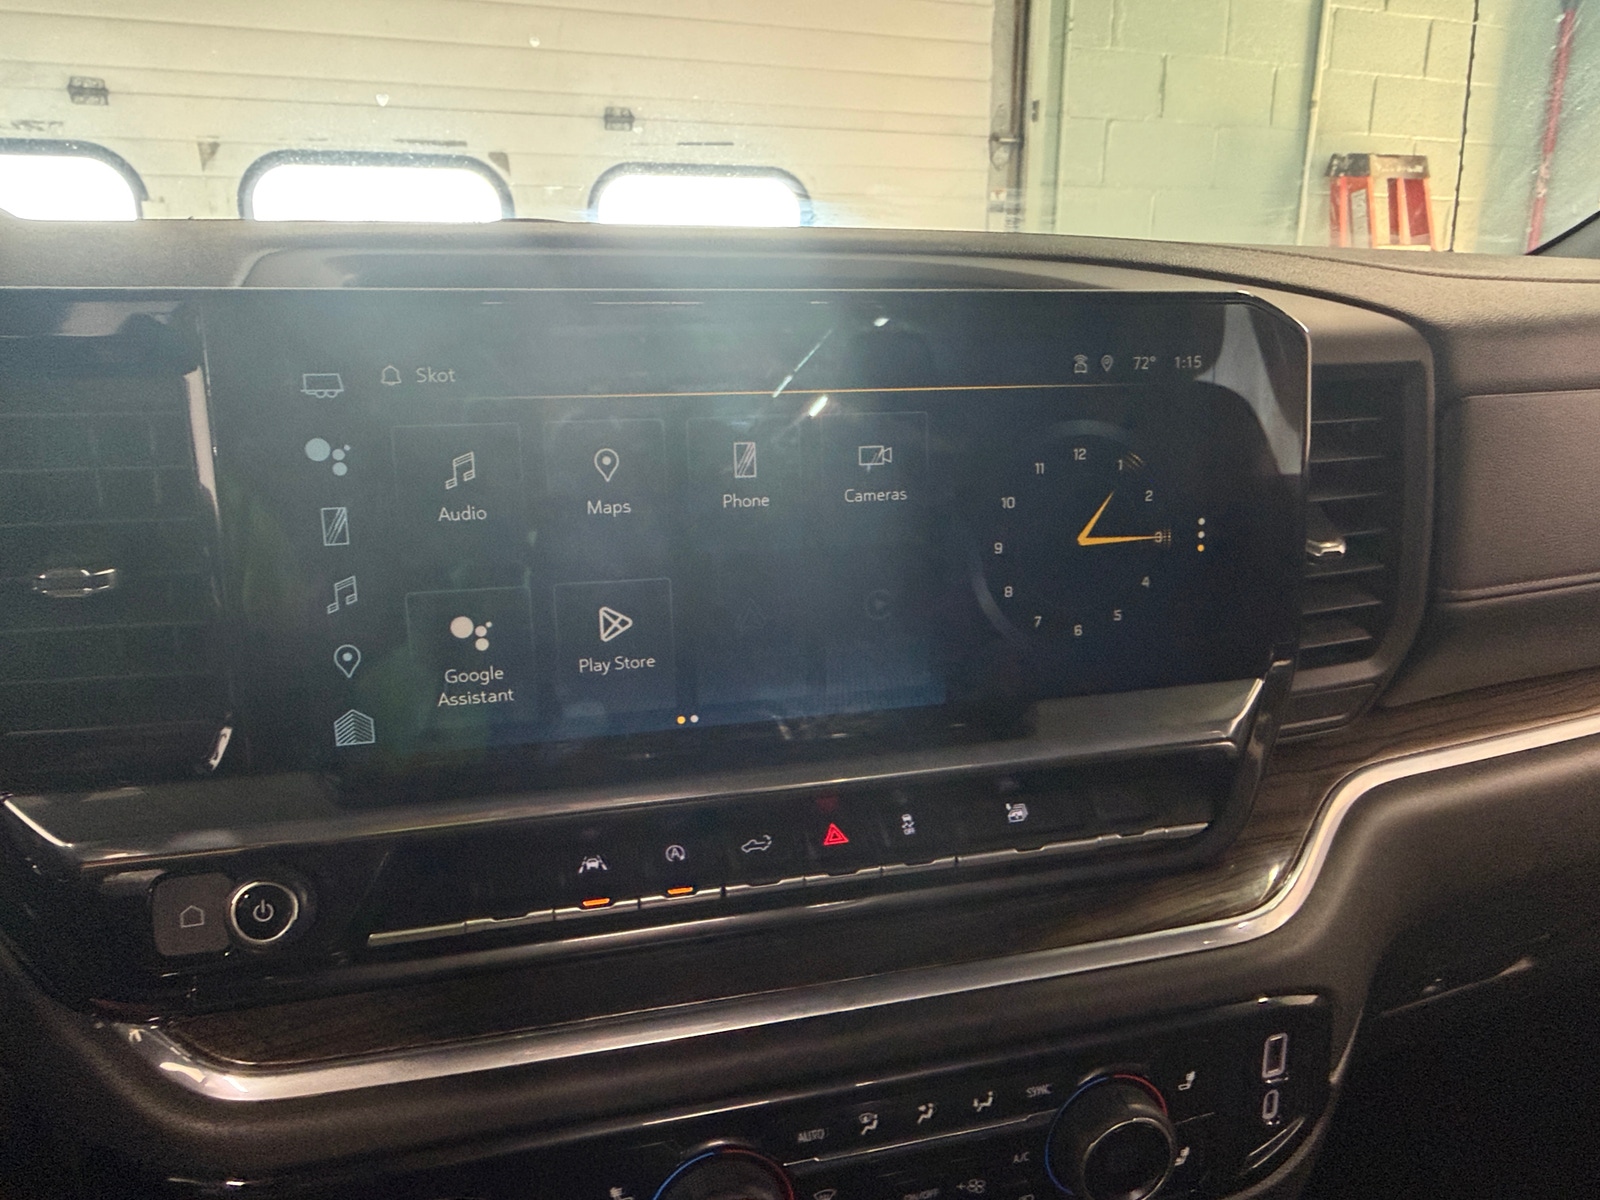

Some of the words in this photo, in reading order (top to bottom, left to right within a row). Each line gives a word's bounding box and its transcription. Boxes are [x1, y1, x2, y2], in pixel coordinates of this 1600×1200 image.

[1174, 355, 1202, 370] 1:15
[415, 366, 456, 383] Skot
[1073, 448, 1087, 461] 12
[1034, 463, 1045, 475] 11
[1117, 459, 1124, 471] 1
[722, 494, 770, 509] Phone
[843, 488, 908, 505] Cameras
[1144, 489, 1154, 502] 2
[586, 500, 632, 517] Maps
[1001, 496, 1016, 510] 10
[438, 505, 487, 522] Audio
[1154, 531, 1164, 544] 3
[993, 542, 1003, 555] 9
[1140, 576, 1151, 588] 4
[1003, 586, 1014, 598] 8
[1034, 615, 1043, 628] 7
[1113, 609, 1123, 622] 5
[1073, 624, 1083, 637] 6
[578, 658, 611, 676] Play
[614, 656, 656, 671] Store
[444, 665, 504, 686] Google
[437, 689, 515, 708] Assistant
[1025, 1084, 1053, 1098] SYNC
[797, 1128, 826, 1143] AUTO
